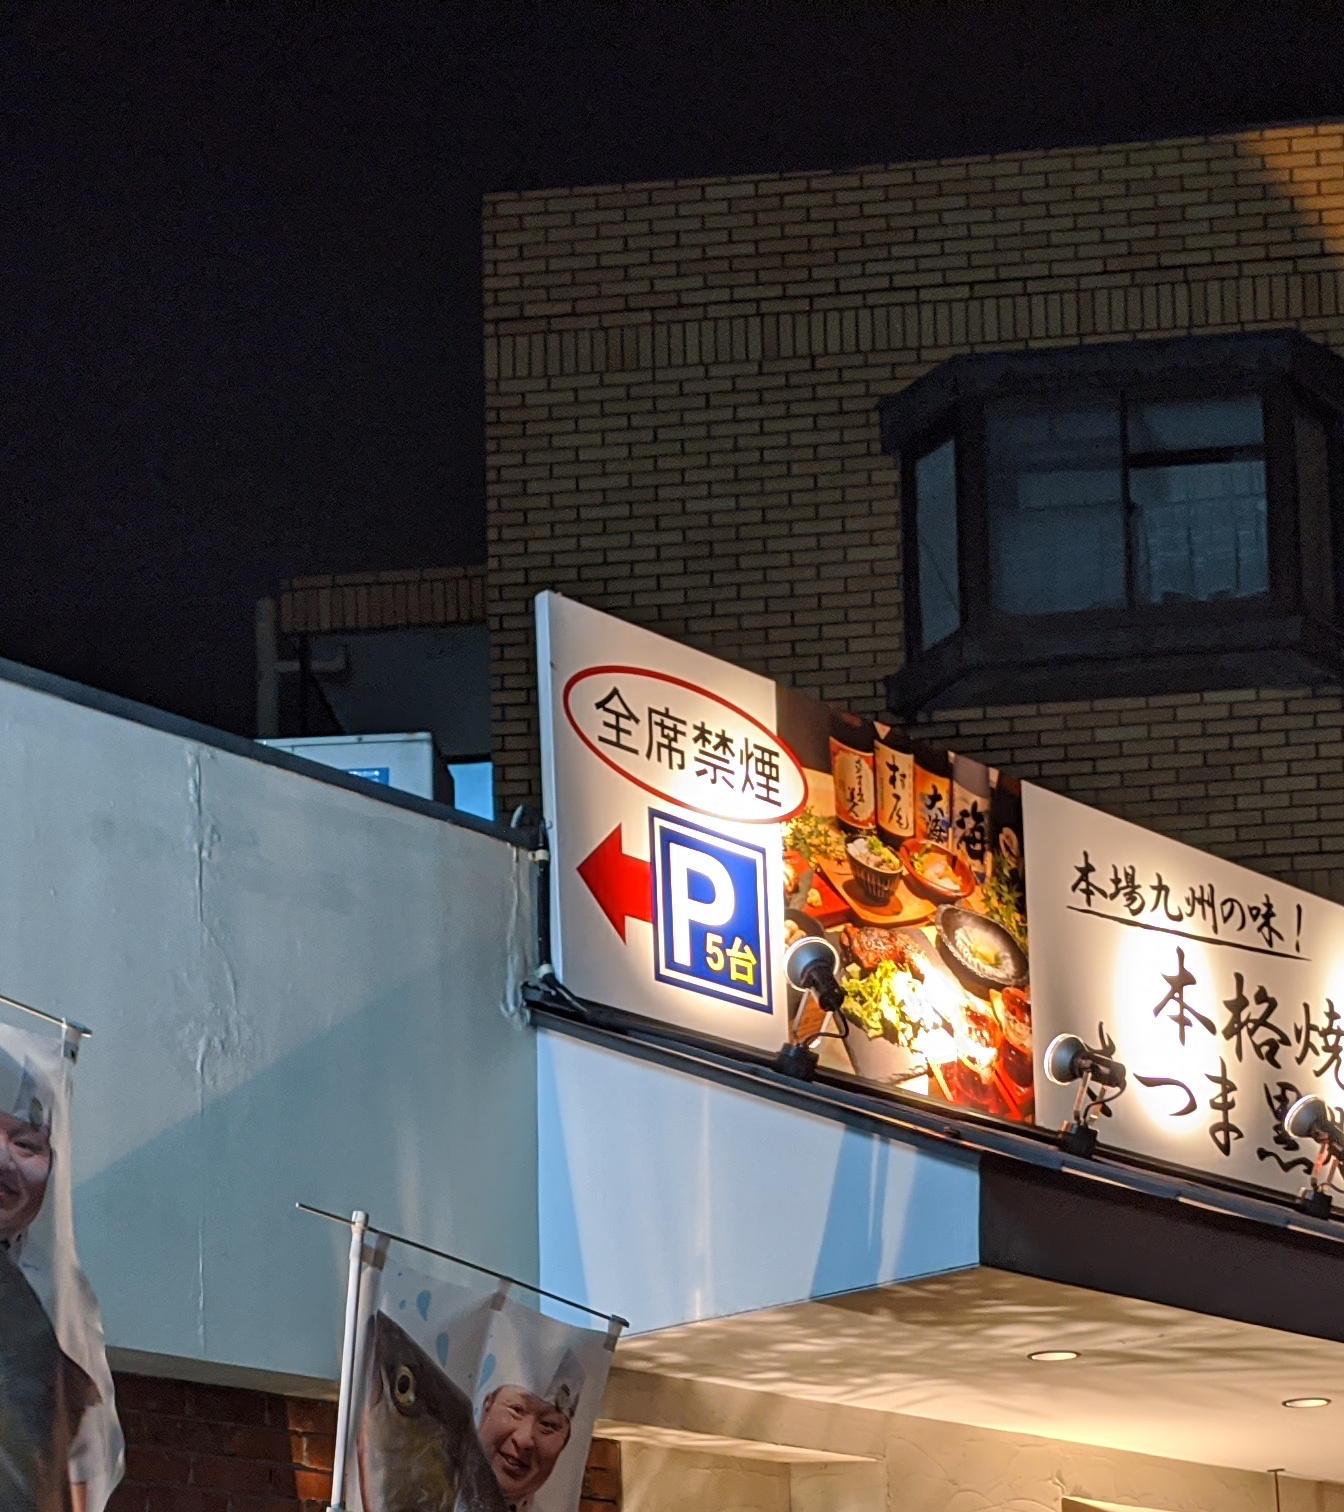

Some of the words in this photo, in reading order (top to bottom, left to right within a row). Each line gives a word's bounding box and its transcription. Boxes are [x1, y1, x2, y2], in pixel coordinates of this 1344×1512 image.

[594, 686, 783, 808] 全席禁煙
[668, 840, 735, 968] P
[1071, 851, 1304, 953] 本場九州の味！
[705, 932, 757, 987] 5台
